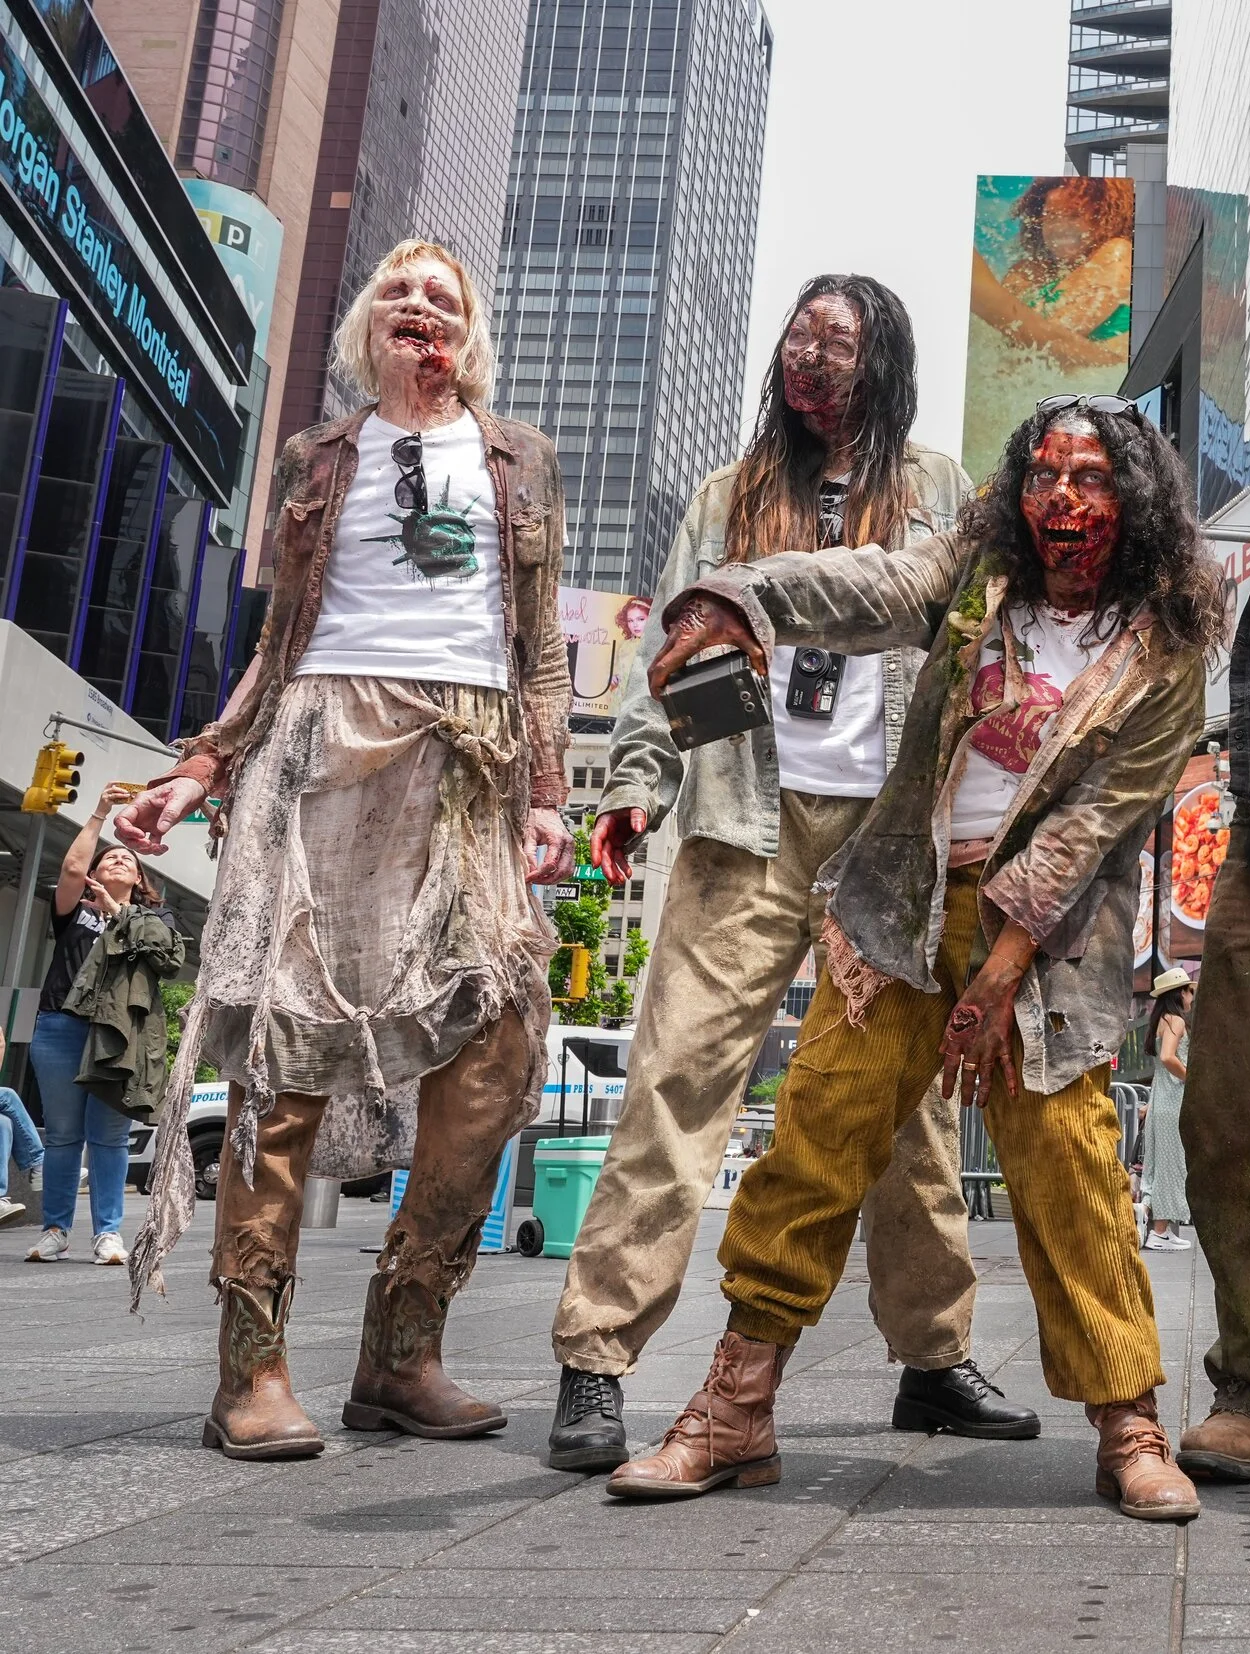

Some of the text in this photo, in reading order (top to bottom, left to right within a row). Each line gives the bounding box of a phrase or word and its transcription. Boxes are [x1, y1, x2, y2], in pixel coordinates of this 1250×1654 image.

[0, 70, 190, 407] organ Stanley Montréal
[573, 1084, 593, 1094] PBS
[195, 1092, 228, 1103] POLIC
